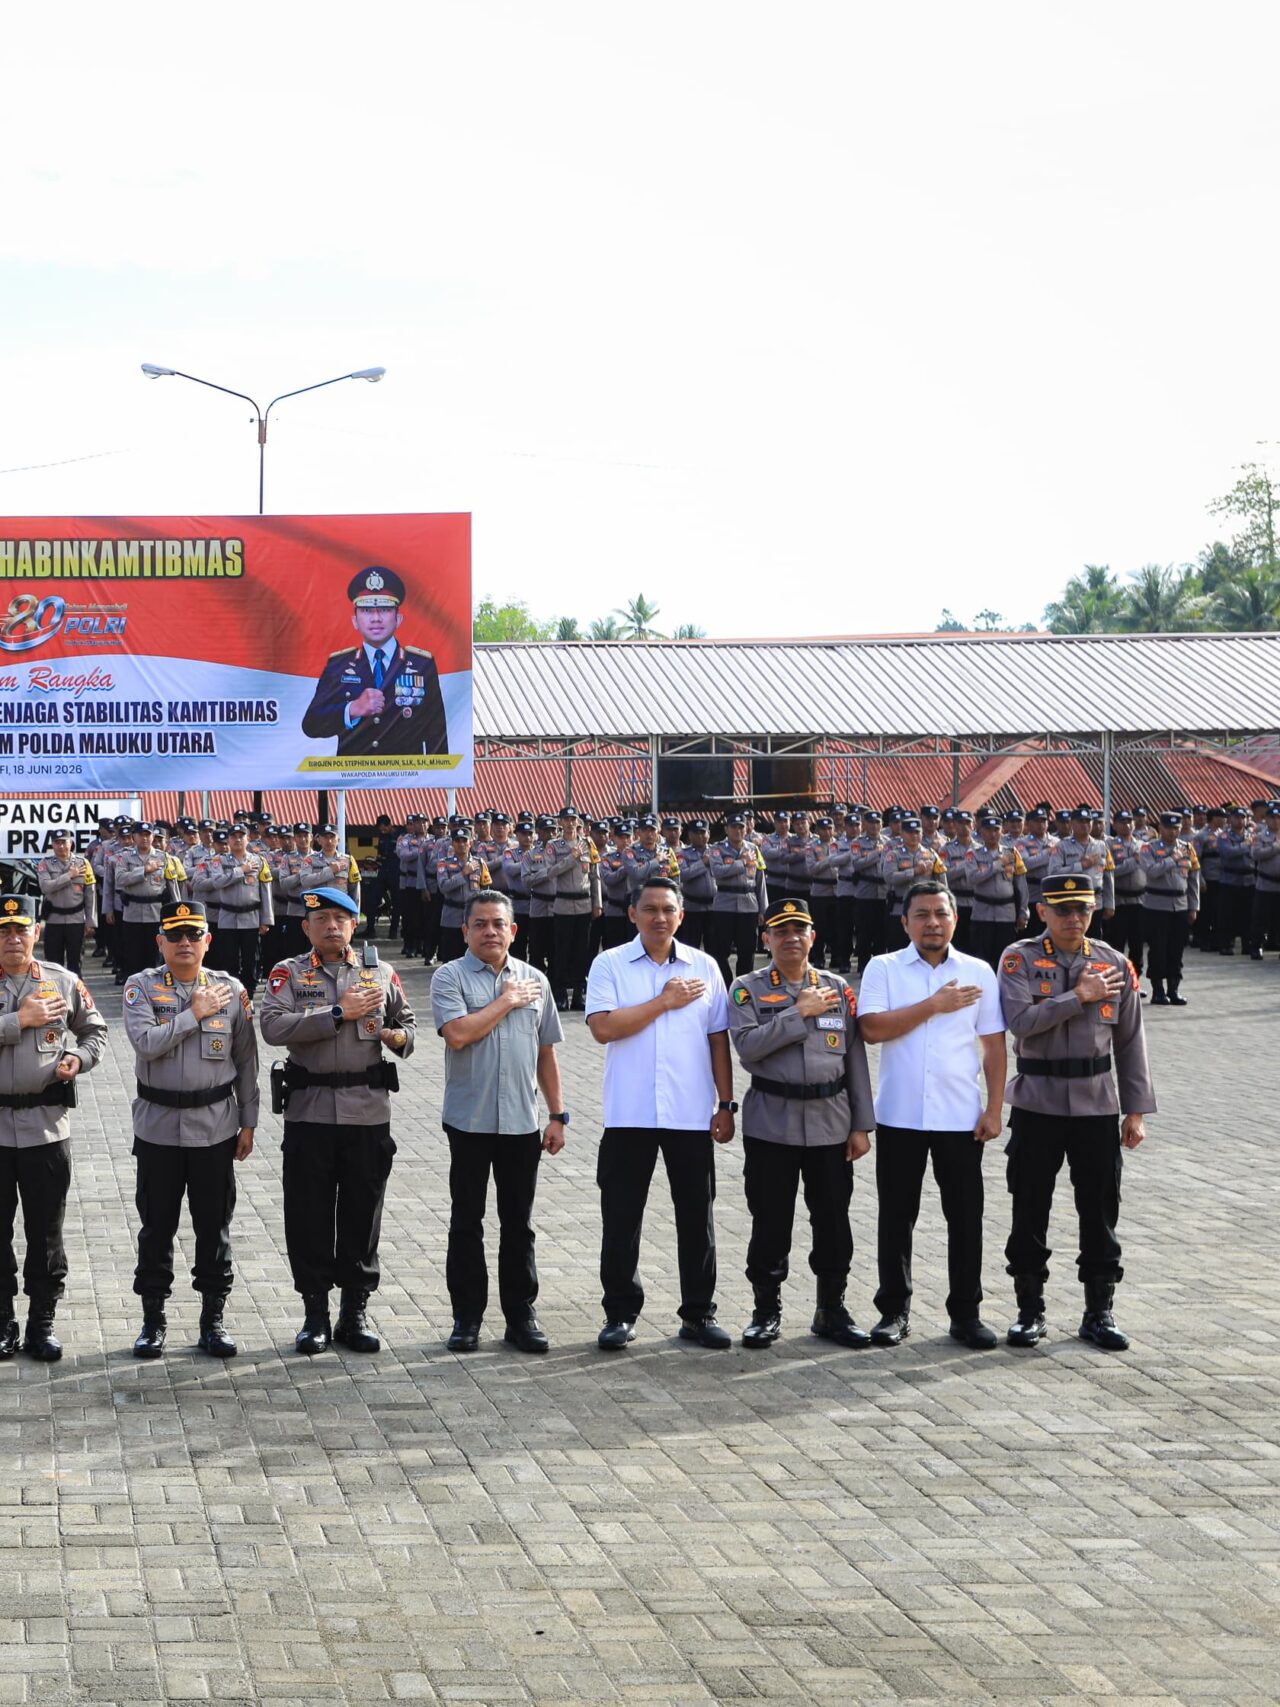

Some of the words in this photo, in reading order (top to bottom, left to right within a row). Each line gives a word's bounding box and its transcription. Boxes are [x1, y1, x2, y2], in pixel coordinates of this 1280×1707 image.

[64, 616, 127, 634] POLRI
[28, 666, 114, 695] Rangka
[63, 701, 163, 724] STABILITAS
[168, 700, 278, 723] KAMTIBMAS
[18, 732, 75, 754] POLDA
[79, 732, 152, 754] MALUKU
[157, 732, 215, 754] UTARA
[13, 765, 24, 774] 18
[27, 765, 52, 774] JUNI
[55, 764, 82, 774] 2026
[7, 829, 100, 854] PRAE
[1035, 971, 1056, 980] ALI
